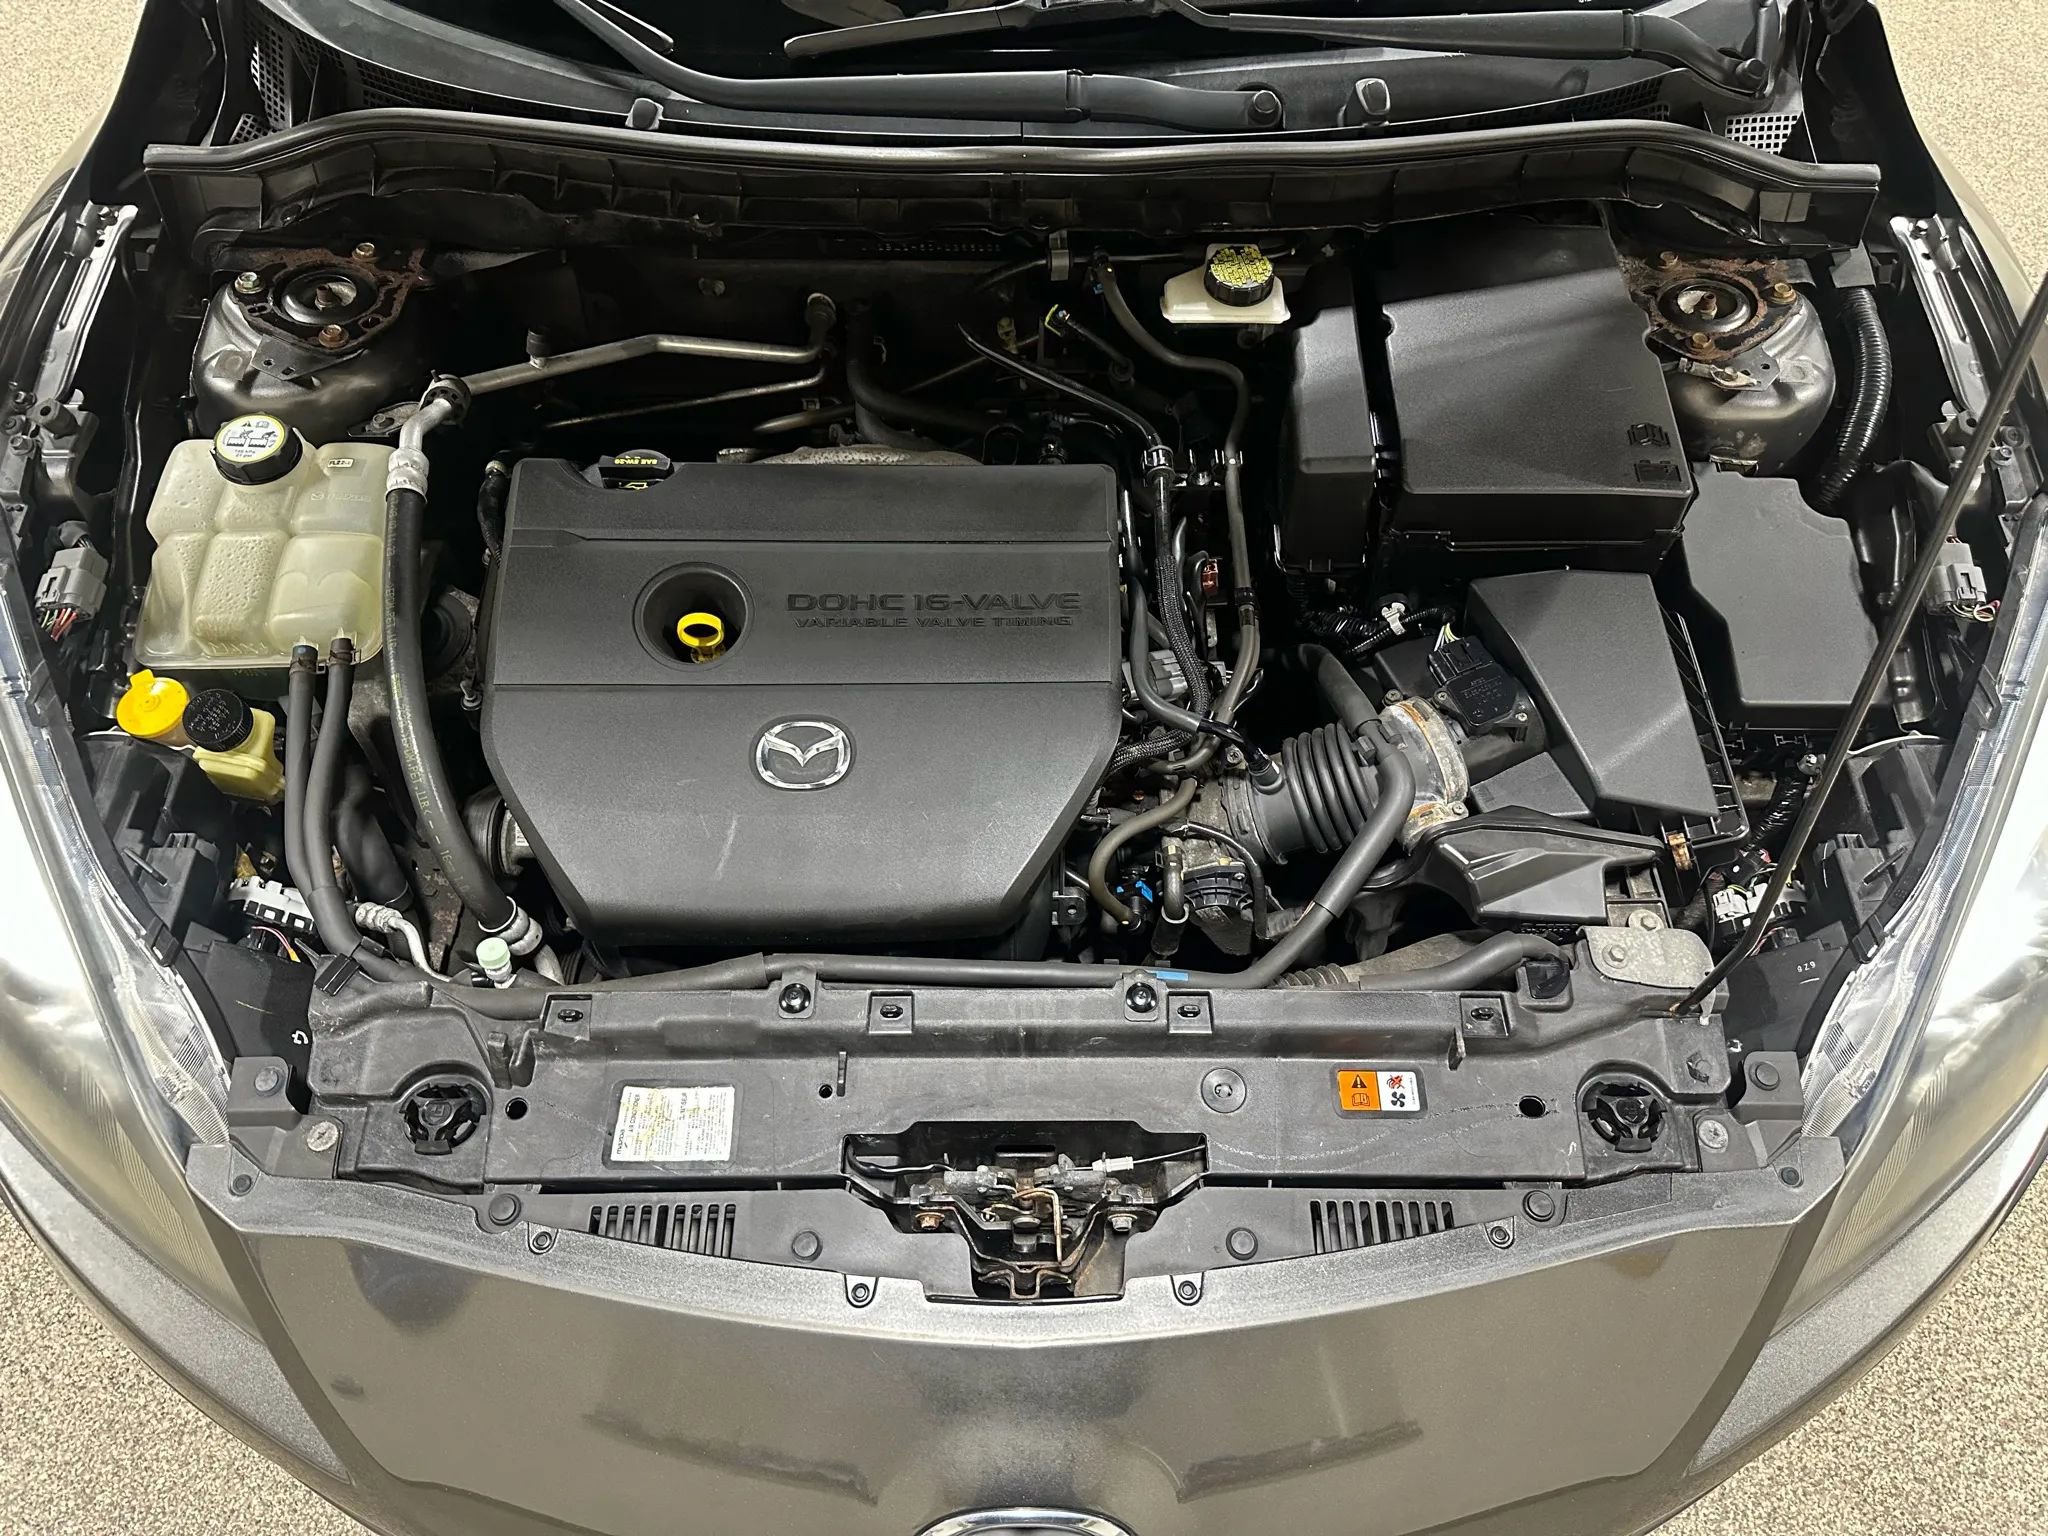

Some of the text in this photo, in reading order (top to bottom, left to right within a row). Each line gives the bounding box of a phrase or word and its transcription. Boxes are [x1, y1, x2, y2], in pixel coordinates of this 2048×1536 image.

[787, 591, 1081, 612] DOHC 16-VALVE
[794, 614, 1073, 628] VARIABLE VALVE TIMING
